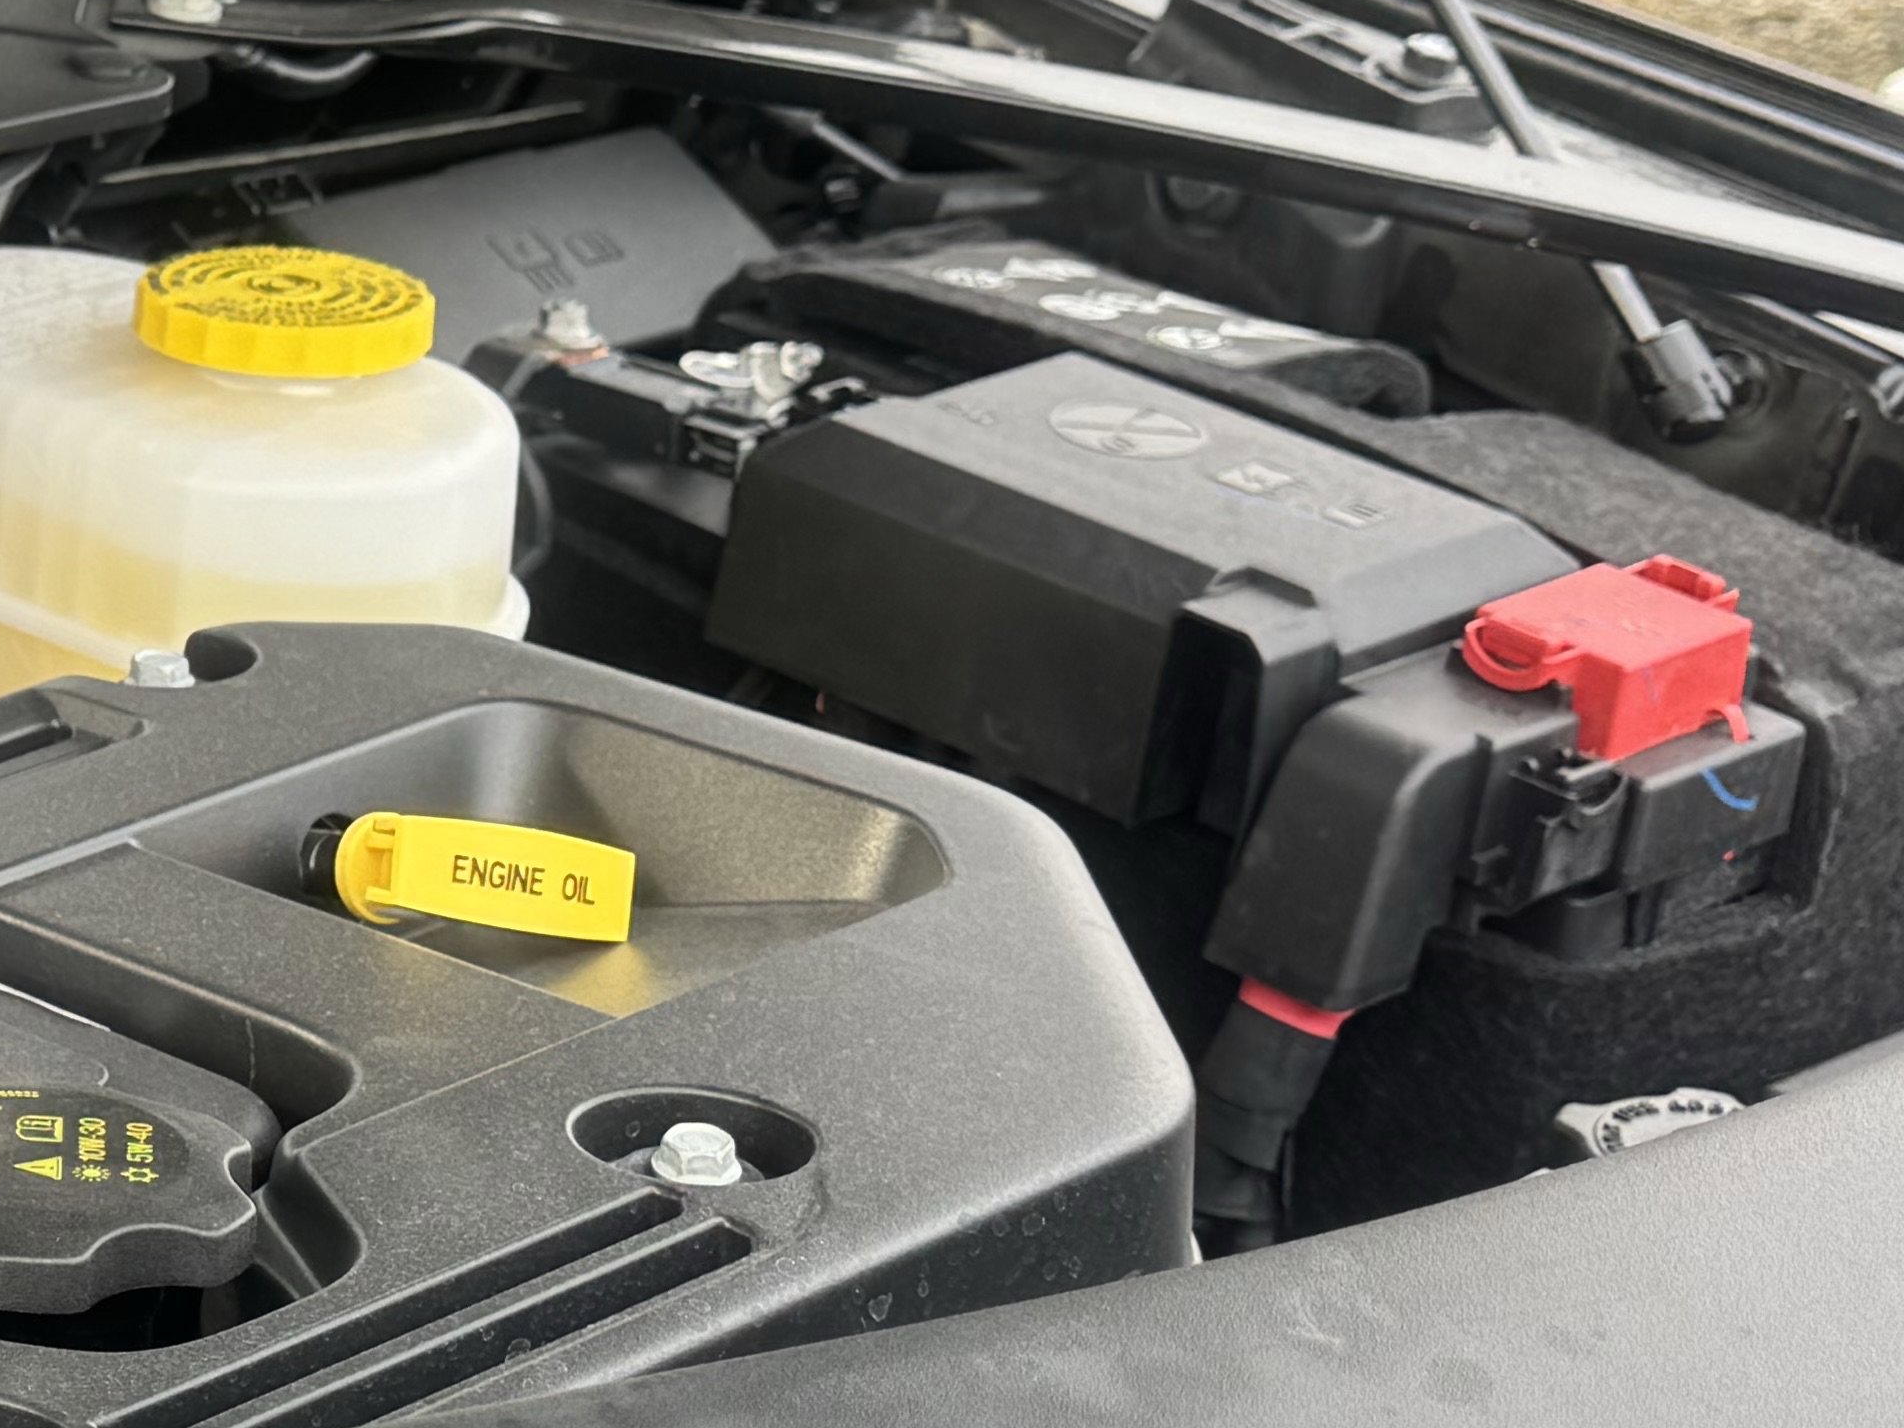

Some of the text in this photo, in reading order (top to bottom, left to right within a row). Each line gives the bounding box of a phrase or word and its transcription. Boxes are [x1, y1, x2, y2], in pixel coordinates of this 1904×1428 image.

[451, 854, 596, 906] ENGINE OIL
[78, 1117, 107, 1162] 10W-30
[126, 1122, 155, 1164] 5W-40
